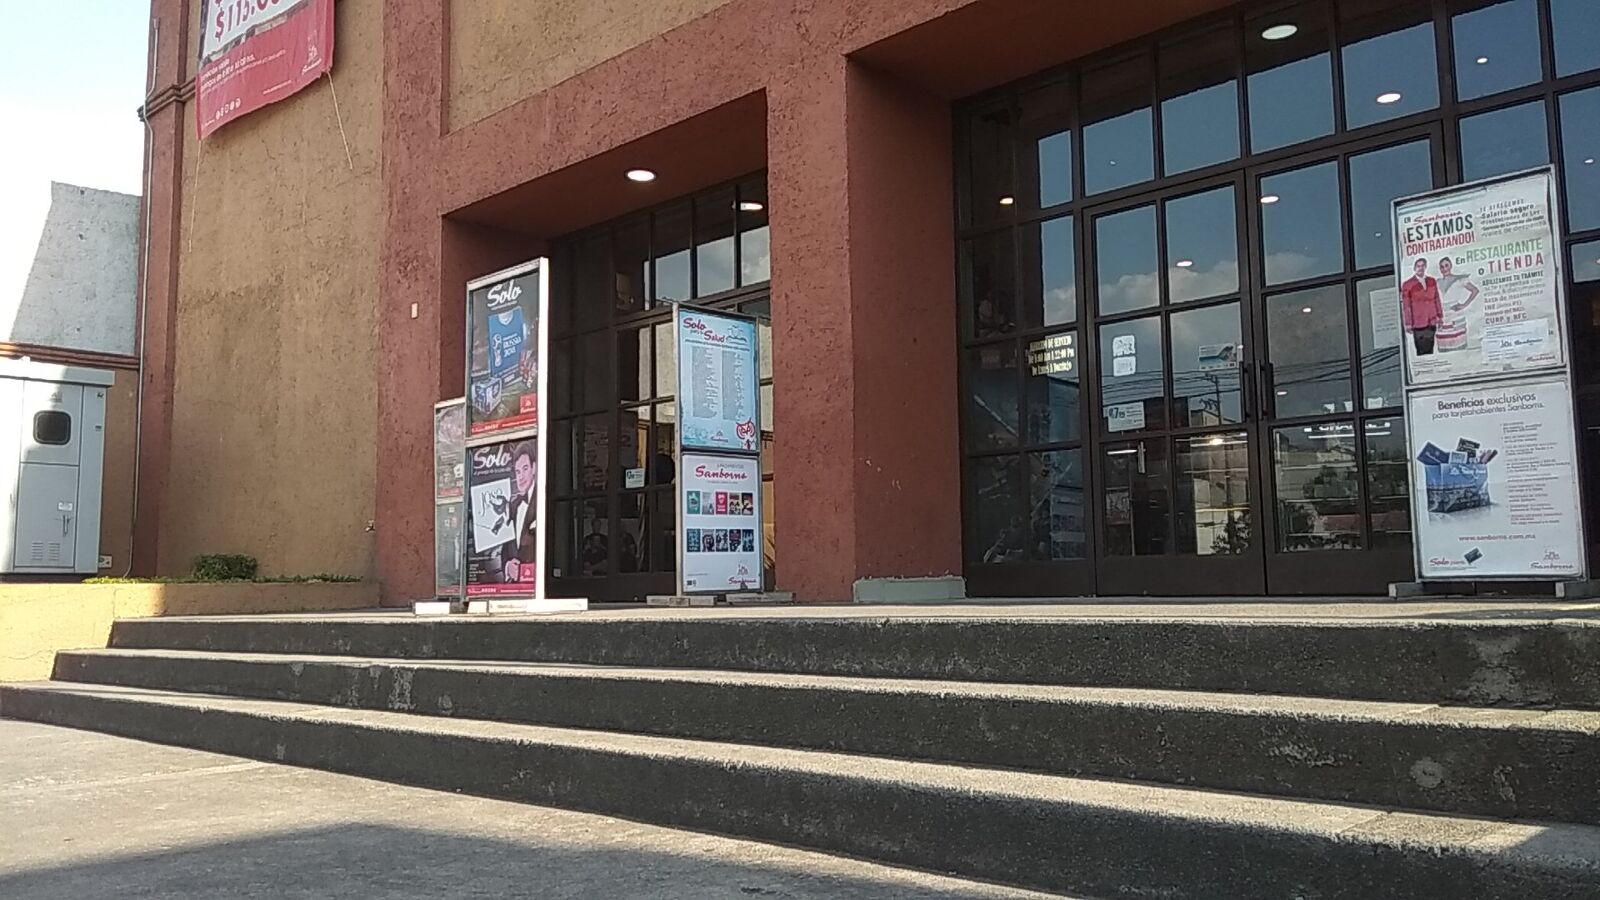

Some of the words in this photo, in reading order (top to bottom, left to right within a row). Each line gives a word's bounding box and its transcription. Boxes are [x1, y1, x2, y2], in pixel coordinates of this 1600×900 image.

[214, 0, 281, 41] $115.
[1413, 211, 1464, 226] Sanborns
[1481, 209, 1508, 219] Salario
[1510, 204, 1534, 214] seguro
[1403, 214, 1474, 244] ¡ESTAMOS
[1406, 231, 1475, 257] CONTRATANDO!
[1456, 257, 1465, 265] En
[1466, 237, 1543, 262] RESTAURANTE
[1488, 252, 1544, 274] TIENDA
[487, 279, 522, 307] Solo
[683, 317, 707, 330] Solo
[1485, 316, 1504, 325] CURP
[1513, 312, 1527, 320] RFC
[704, 330, 725, 343] Salud
[1438, 397, 1484, 410] Beneficios
[1486, 393, 1536, 405] exclusivos
[1432, 412, 1449, 420] para
[1450, 407, 1506, 419] tarjetahabientes
[474, 444, 512, 469] Solo
[695, 465, 748, 479] Sanborns
[1458, 533, 1536, 542] www.sanborns.com.mx
[1530, 562, 1574, 571] Sanborns
